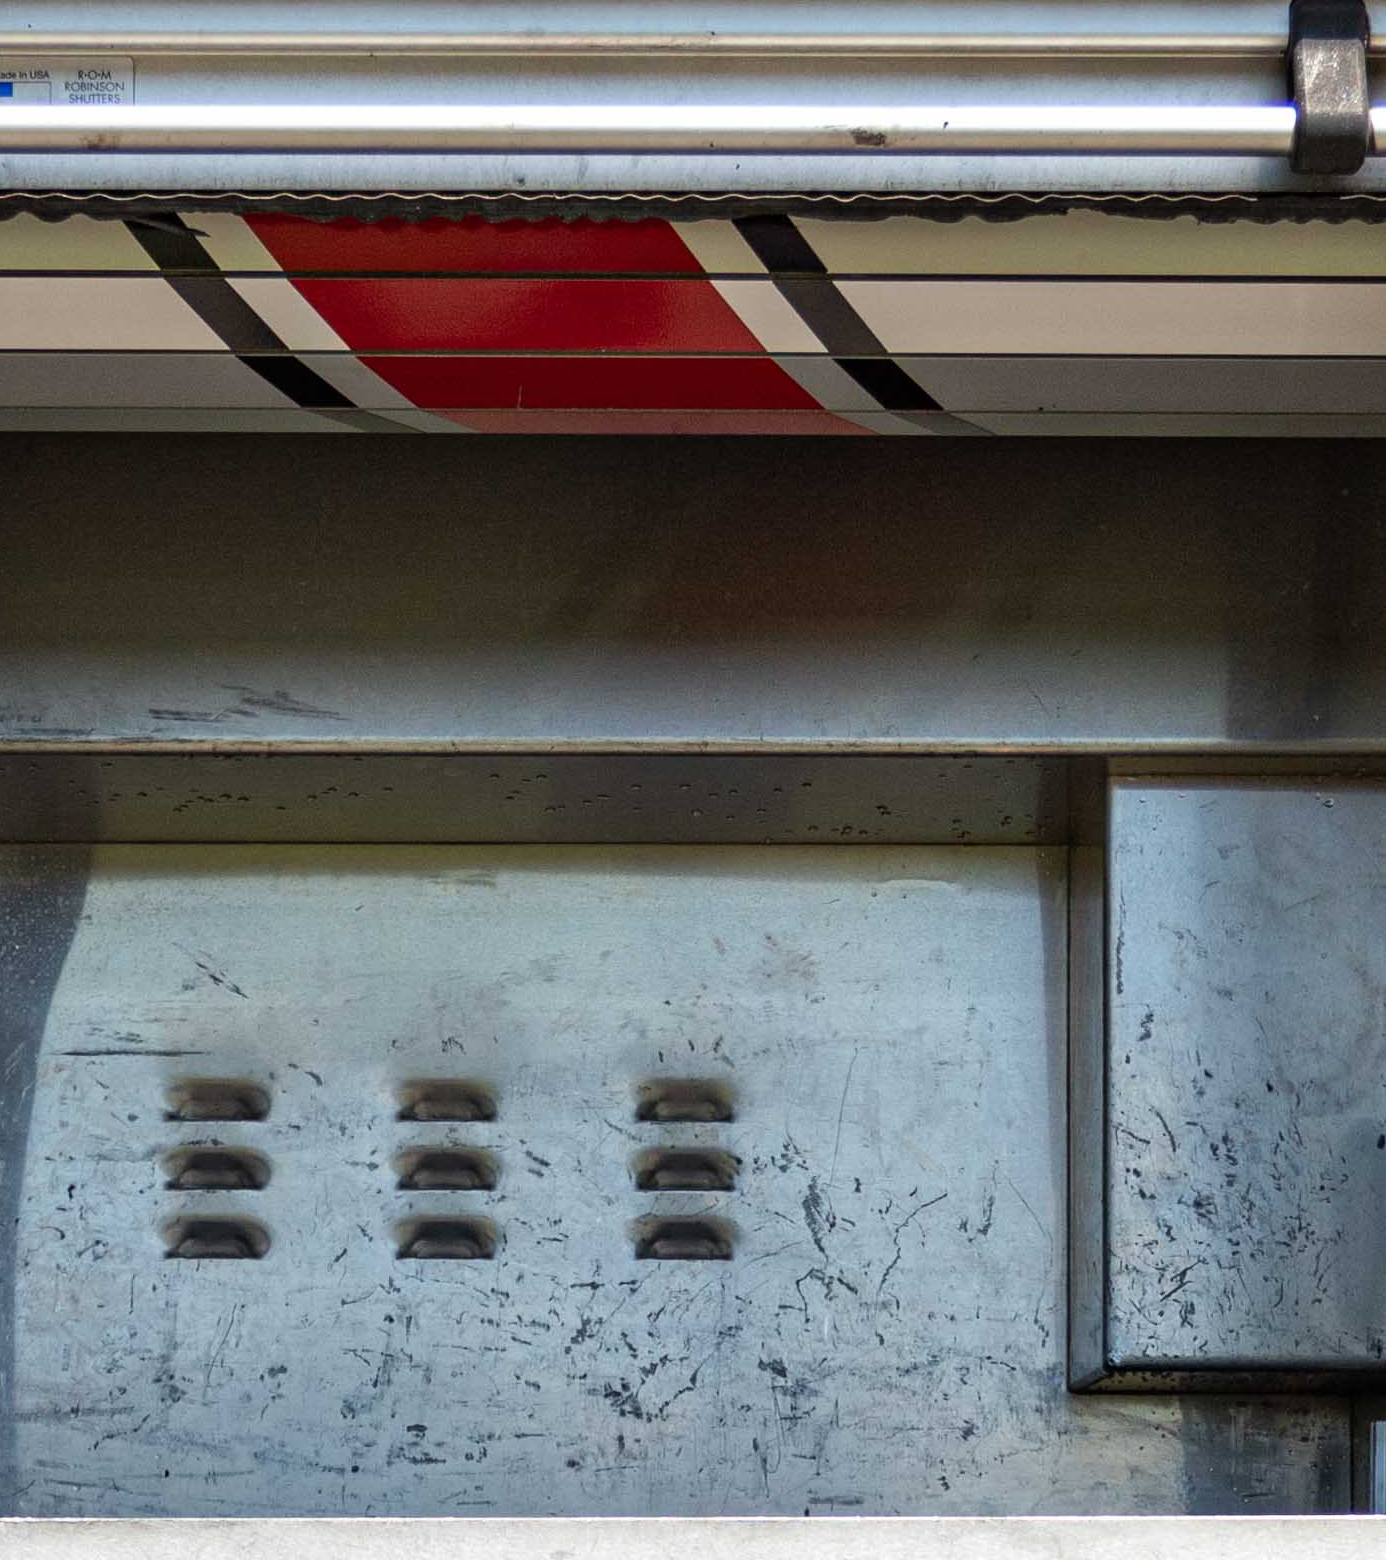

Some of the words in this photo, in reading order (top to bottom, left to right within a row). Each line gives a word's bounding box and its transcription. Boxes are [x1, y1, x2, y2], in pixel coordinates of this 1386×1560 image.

[29, 71, 50, 80] USA
[64, 81, 125, 92] ROBINSON
[69, 93, 121, 104] SHUTTERS
